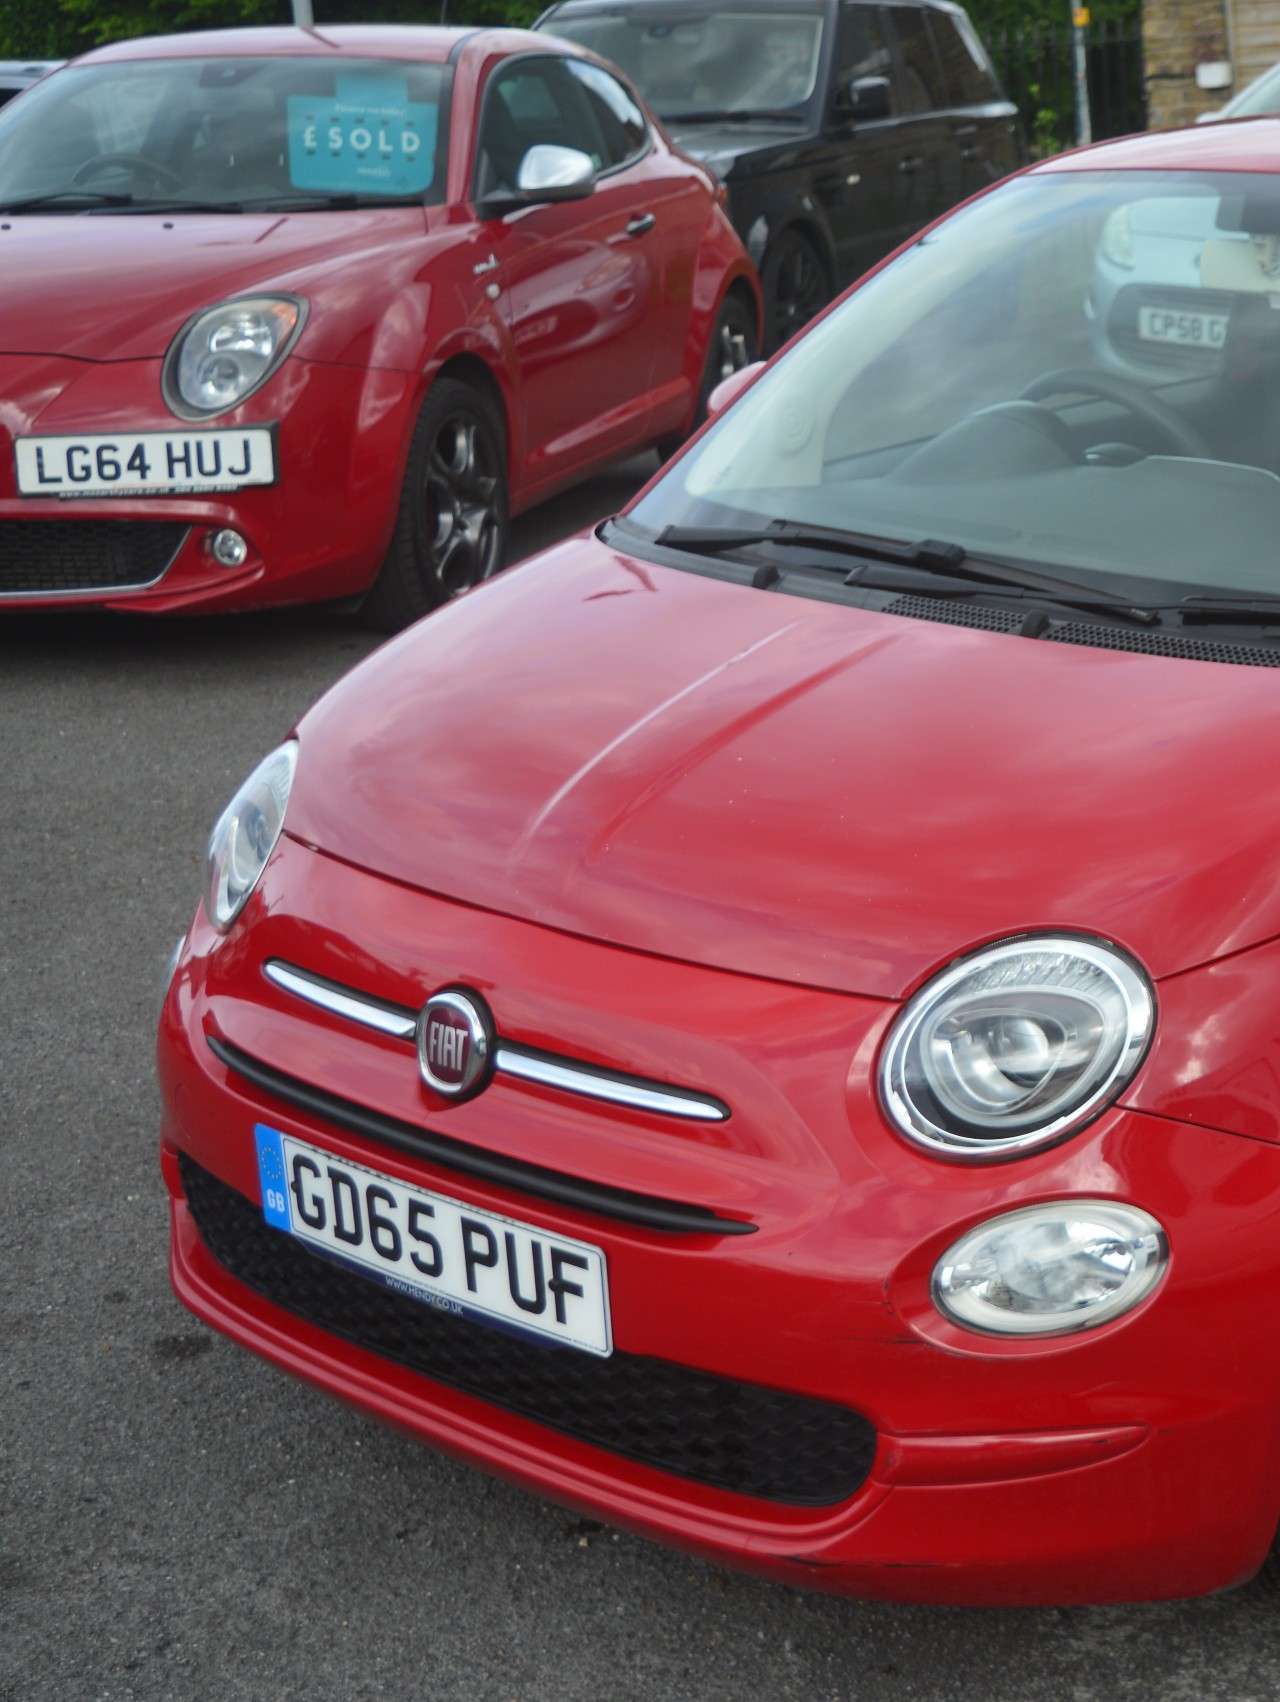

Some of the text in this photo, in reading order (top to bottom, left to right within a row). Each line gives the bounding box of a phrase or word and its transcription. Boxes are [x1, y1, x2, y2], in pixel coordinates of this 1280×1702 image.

[328, 127, 421, 153] SOLD
[36, 438, 252, 484] LG64 HUJ
[429, 1020, 469, 1072] FIAT
[266, 1187, 286, 1214] GB
[290, 1152, 590, 1325] GD65 PUF
